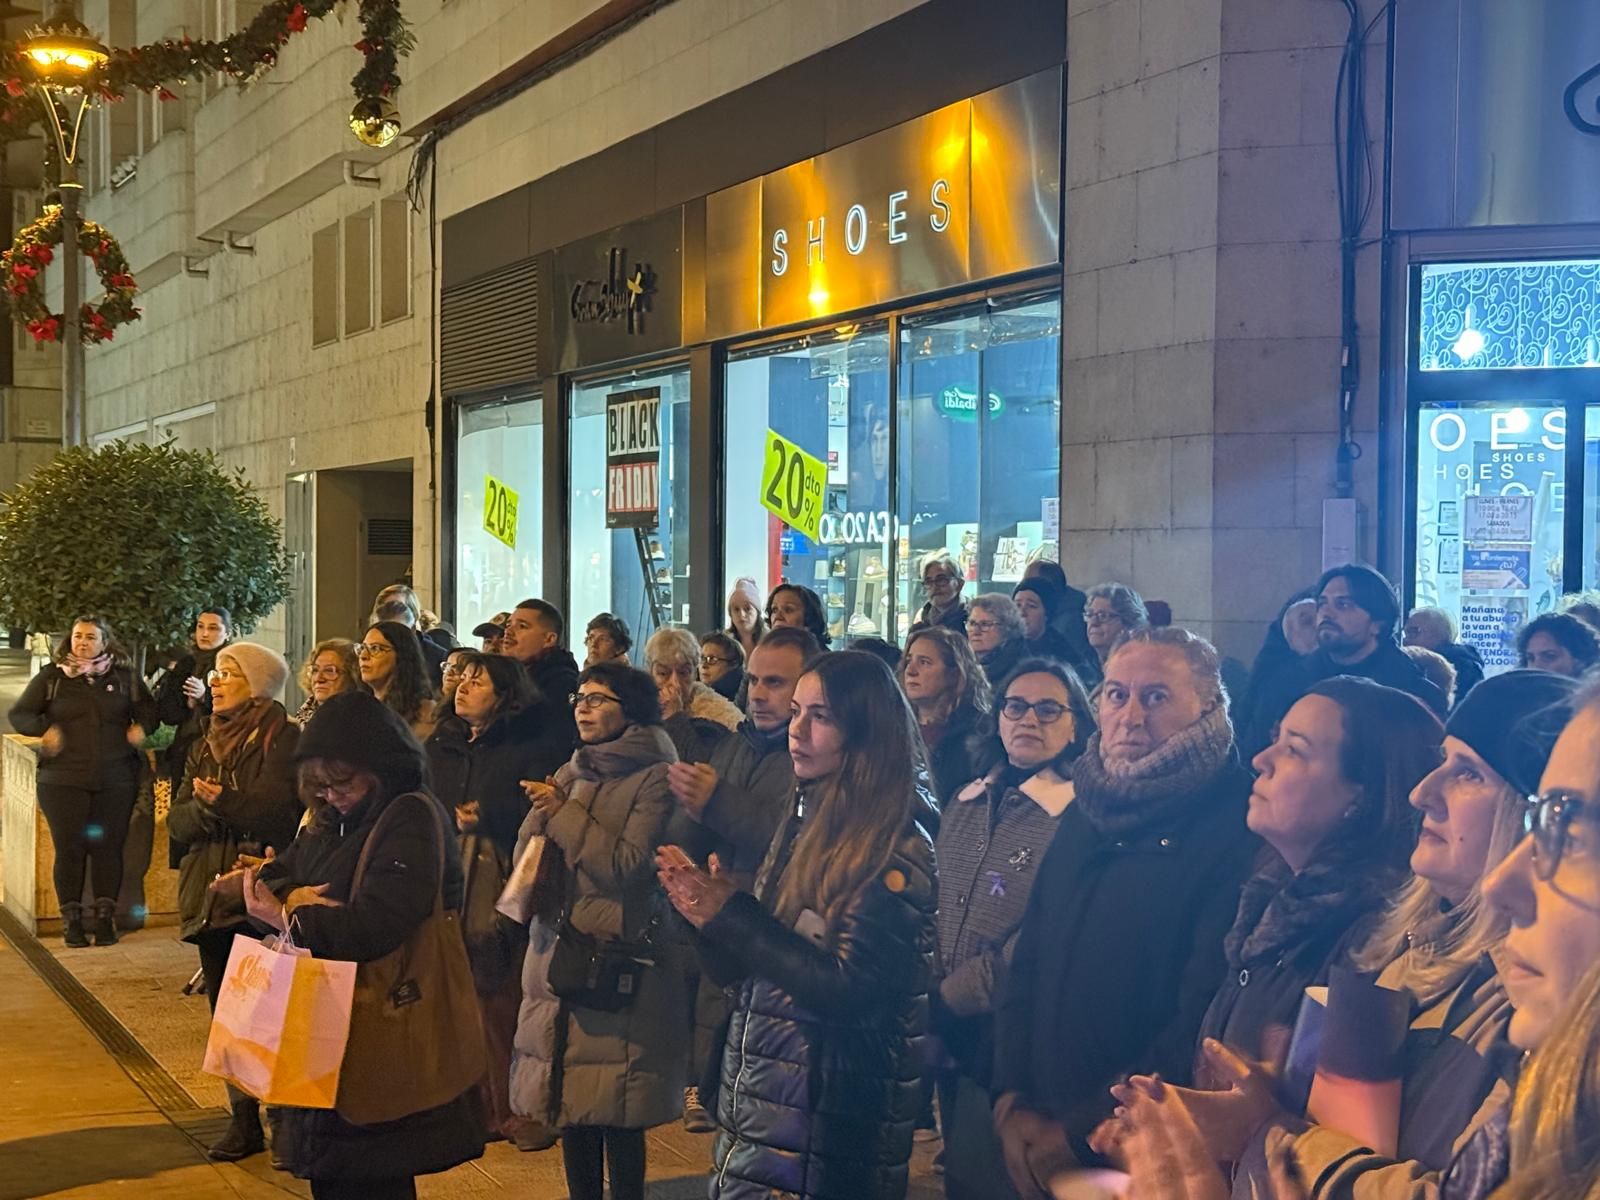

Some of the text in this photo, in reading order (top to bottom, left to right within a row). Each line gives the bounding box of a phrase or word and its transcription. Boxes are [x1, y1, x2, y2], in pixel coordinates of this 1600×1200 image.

[772, 178, 952, 277] SHOES
[609, 401, 660, 452] BLACK
[766, 438, 821, 520] 20 dto
[1492, 452, 1546, 463] SHOES
[486, 480, 507, 537] 20
[608, 464, 658, 509] FRIDAY
[1462, 604, 1505, 614] Mañana
[1470, 614, 1481, 622] tu
[1482, 614, 1518, 622] abua
